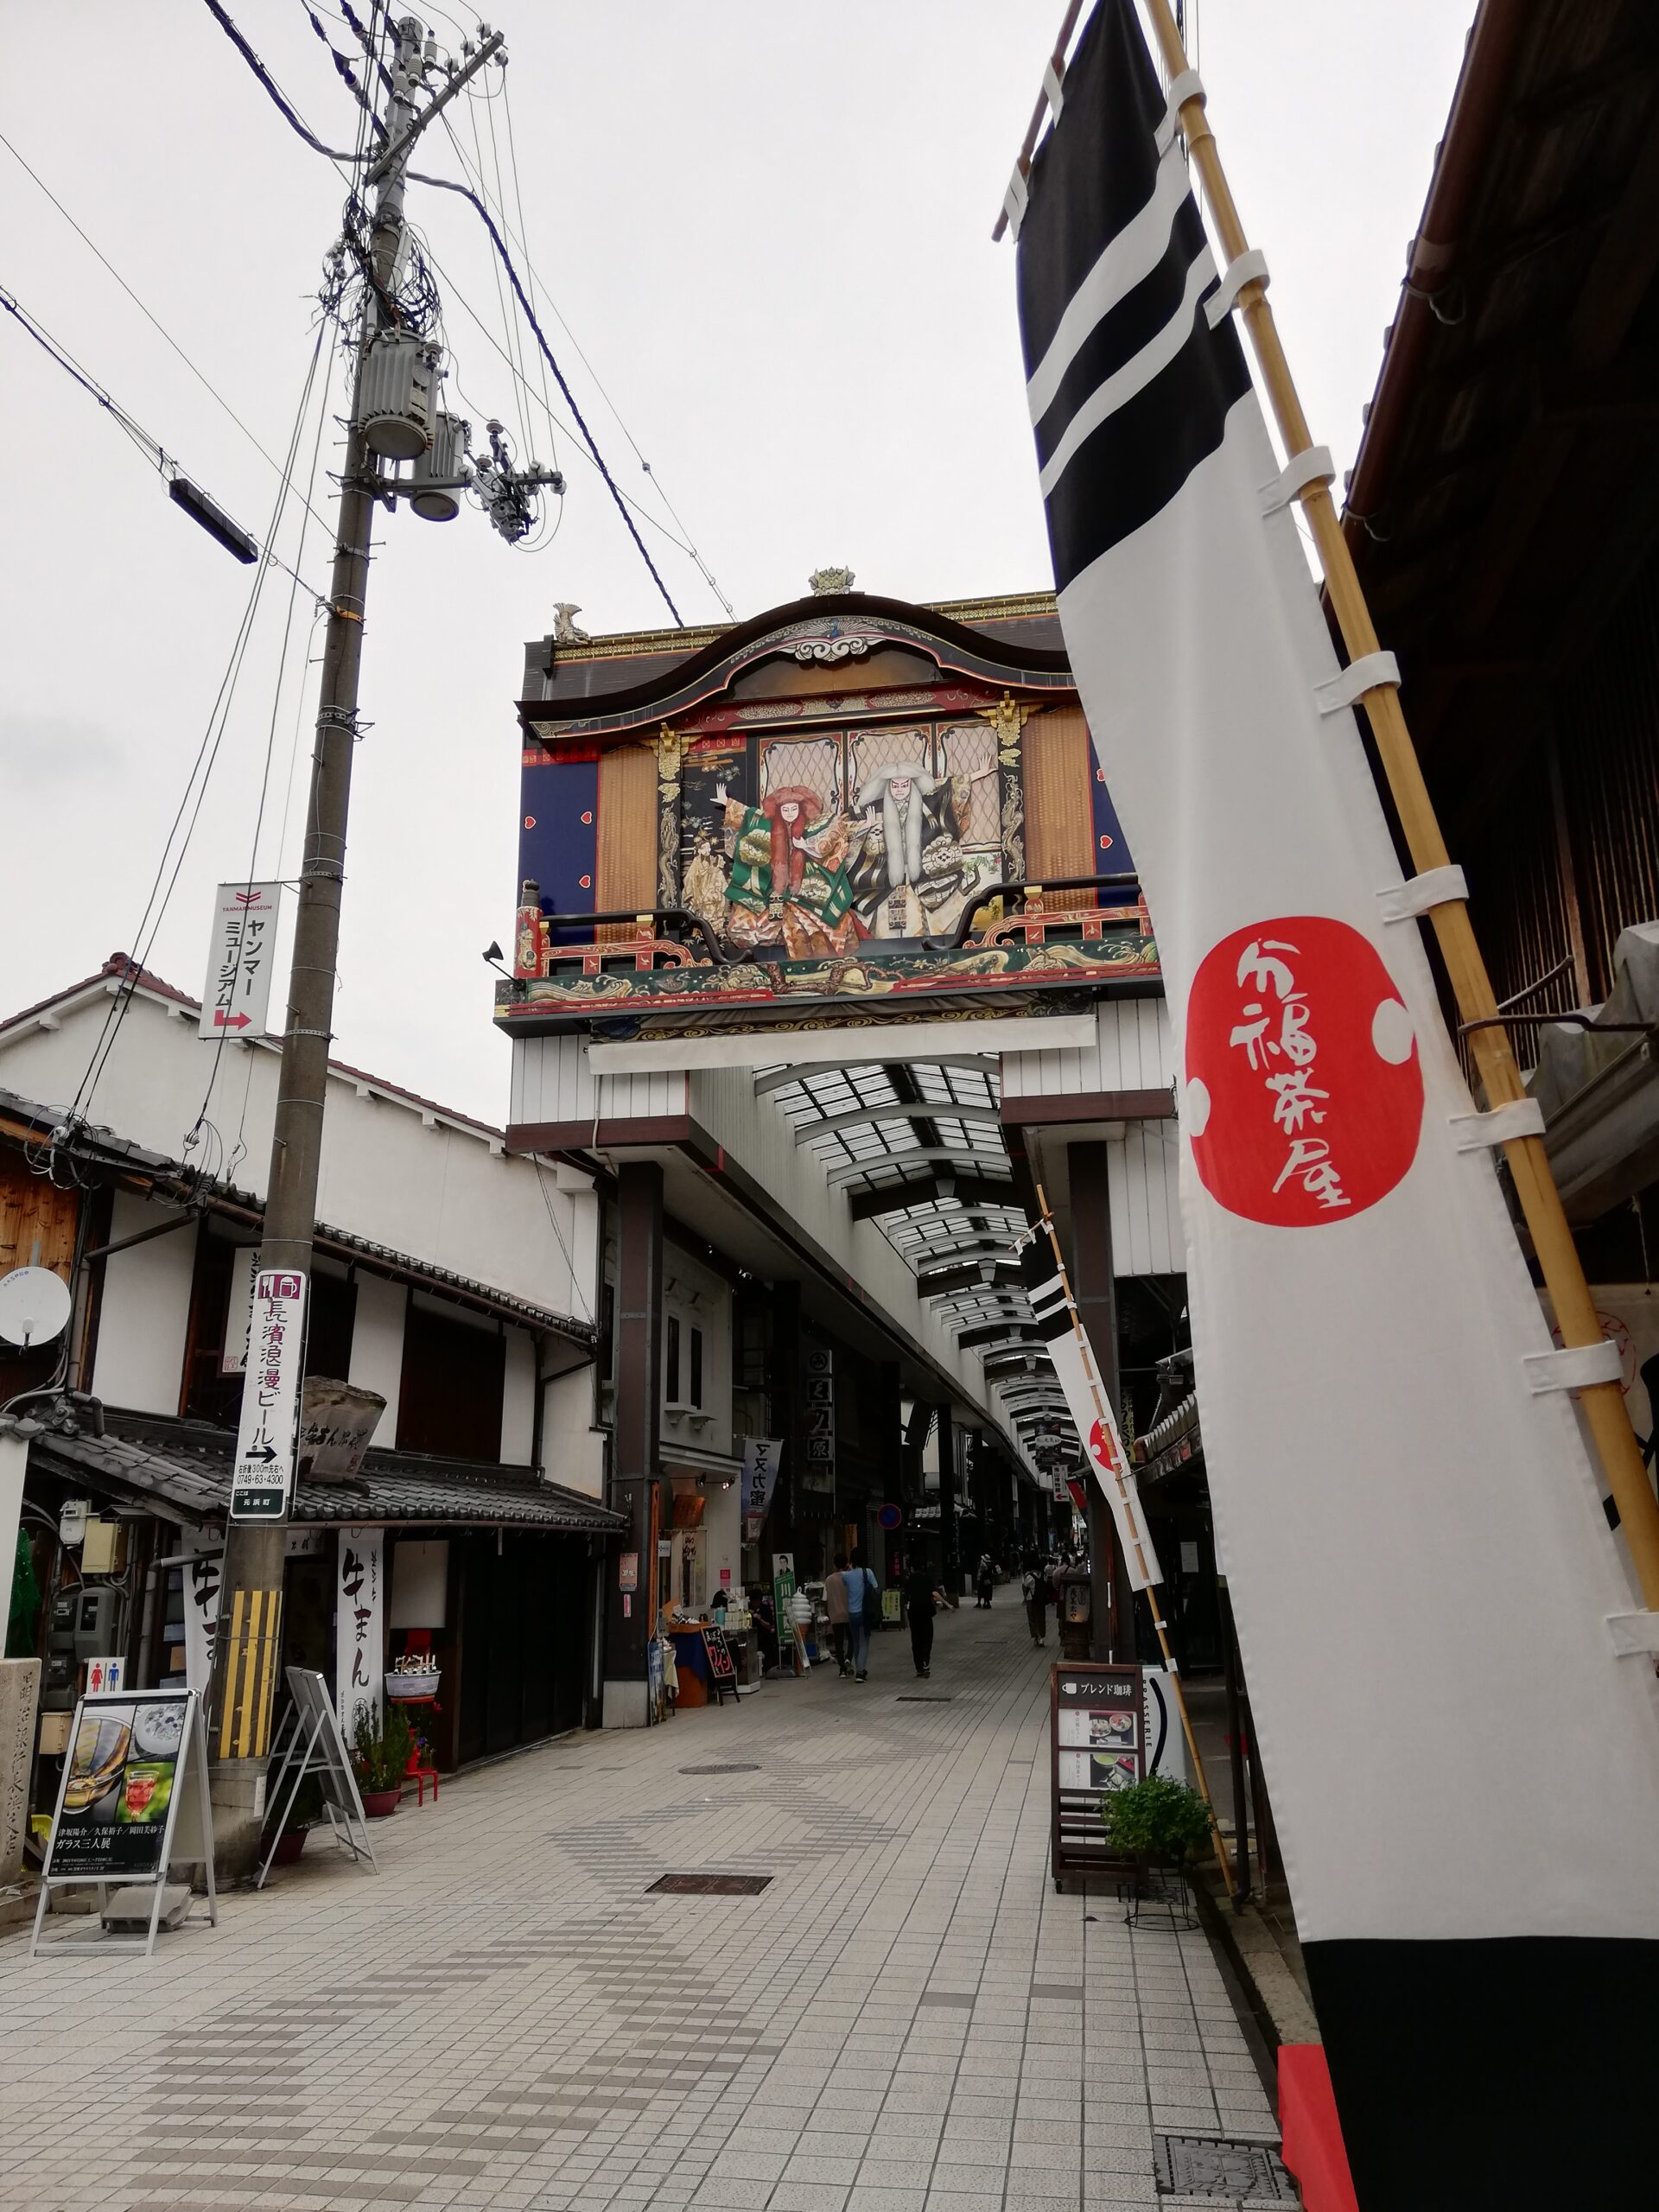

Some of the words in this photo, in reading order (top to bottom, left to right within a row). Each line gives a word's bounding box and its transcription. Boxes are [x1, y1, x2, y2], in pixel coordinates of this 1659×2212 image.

[215, 921, 241, 1007] ミュージアム
[243, 919, 265, 996] ヤンマー
[342, 1548, 372, 1688] 牛まん
[1080, 1682, 1132, 1697] ブレンド珈琲
[55, 1838, 111, 1850] ガラス三人展
